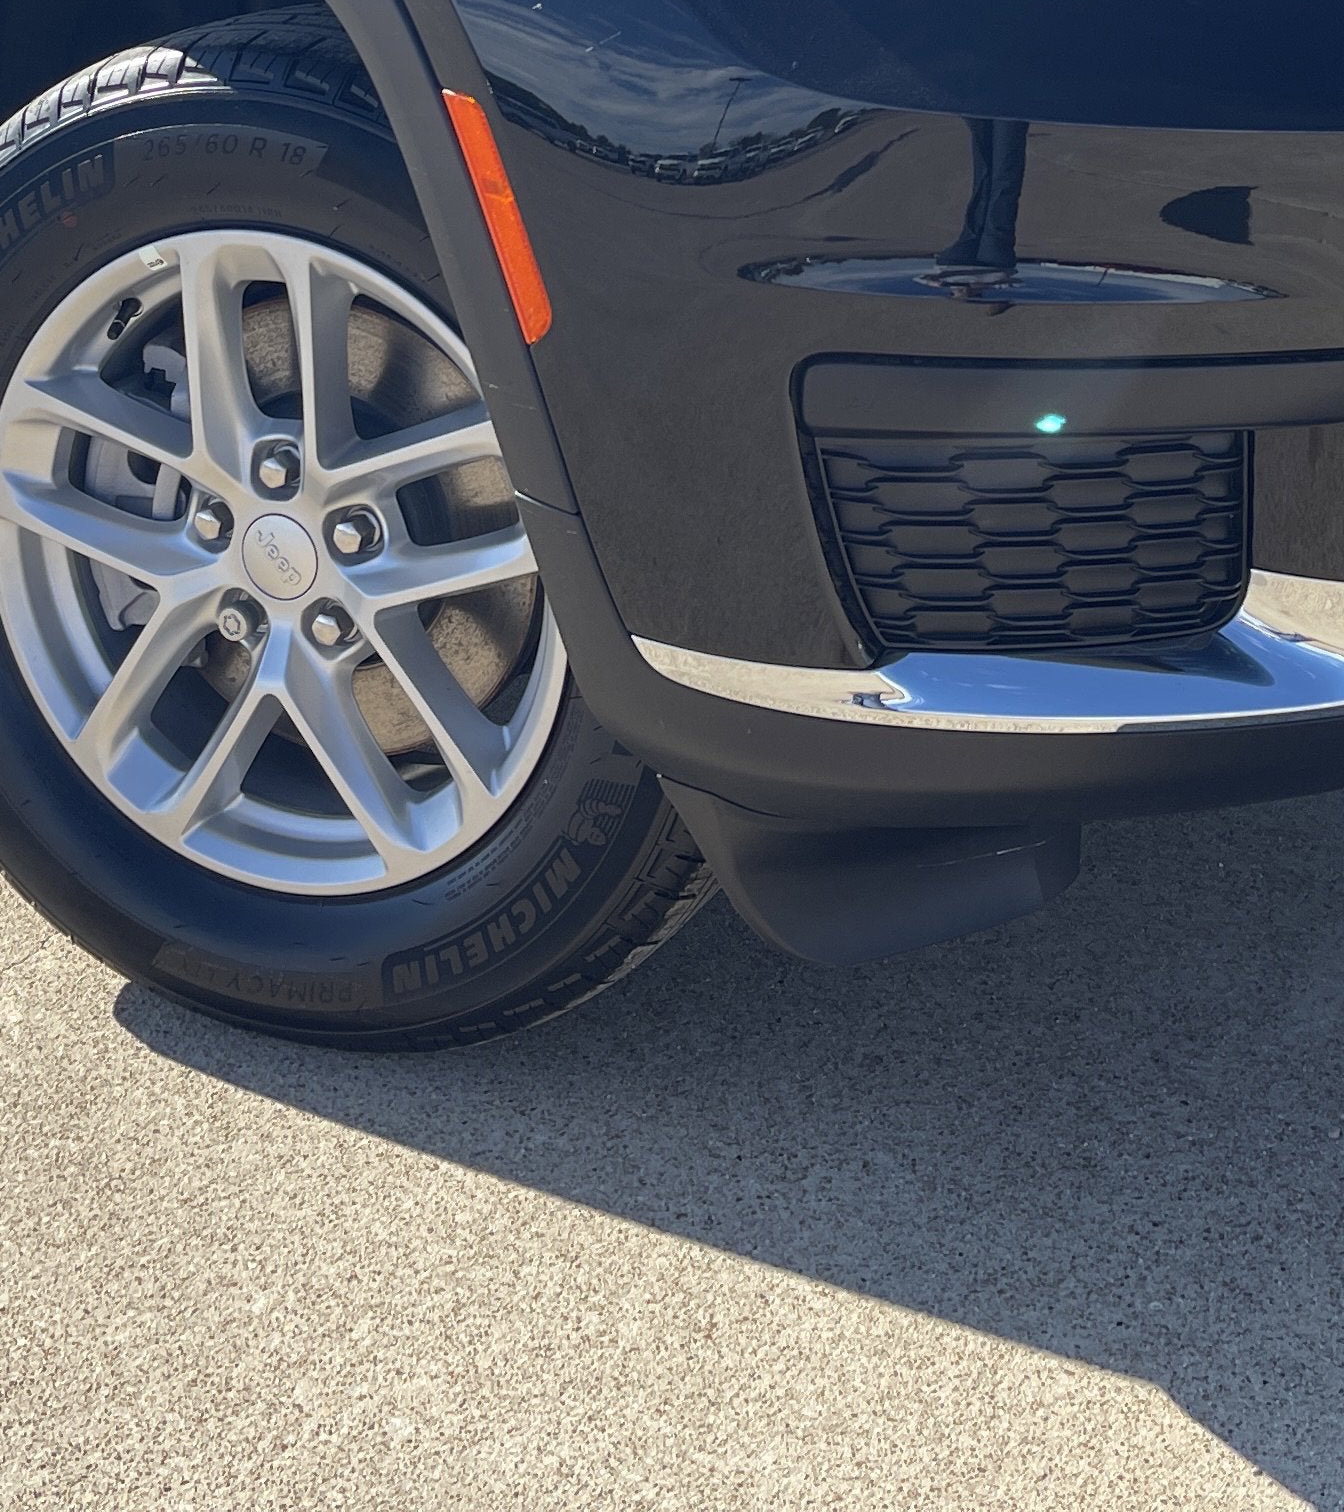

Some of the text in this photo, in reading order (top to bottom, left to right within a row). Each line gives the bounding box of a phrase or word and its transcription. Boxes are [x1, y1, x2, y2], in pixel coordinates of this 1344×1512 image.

[143, 133, 306, 165] 265/60 R 18
[257, 529, 302, 586] Jeep
[392, 848, 582, 994] MICHELIN
[226, 971, 355, 1003] PRIMACY
